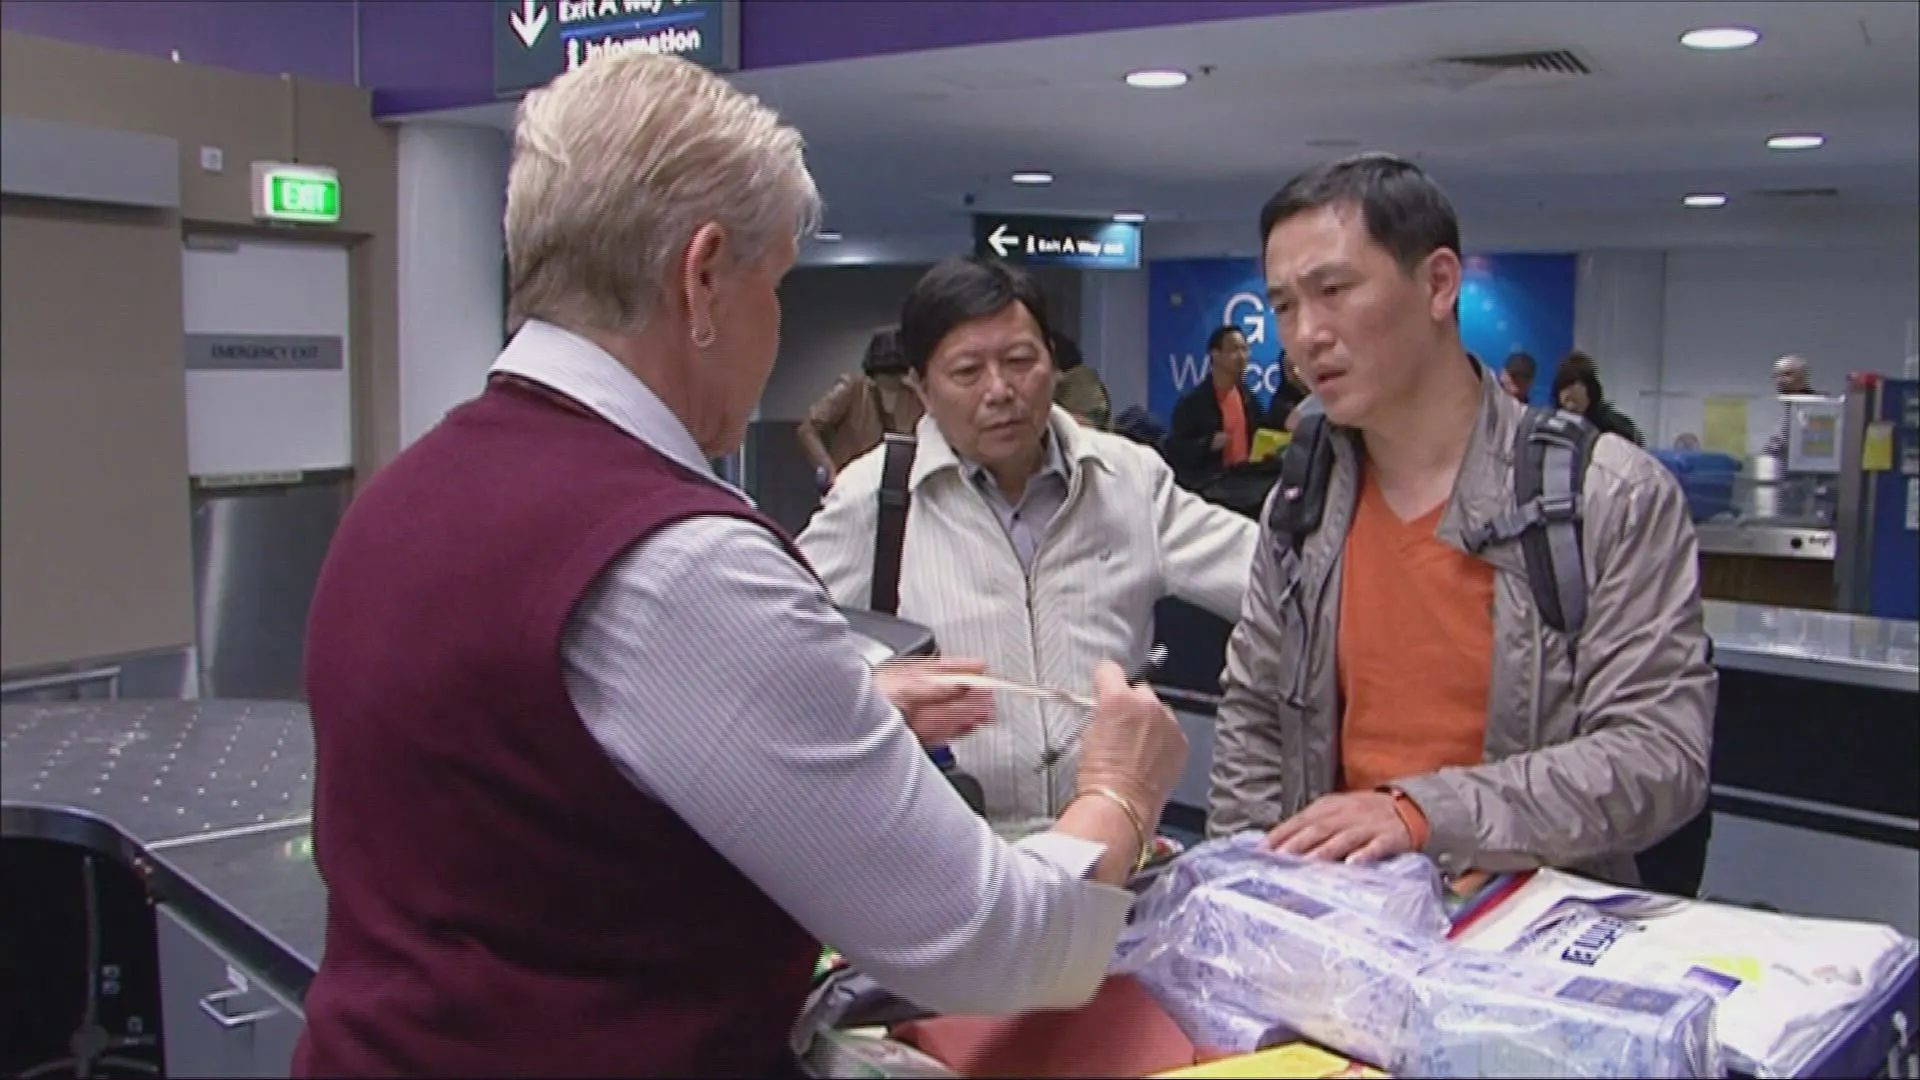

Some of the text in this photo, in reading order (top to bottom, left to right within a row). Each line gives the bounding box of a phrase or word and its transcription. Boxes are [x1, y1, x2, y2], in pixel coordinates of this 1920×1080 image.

[560, 1, 594, 22] Exit
[282, 181, 327, 211] EXIT
[211, 343, 319, 360] EMERGENCY EXIT
